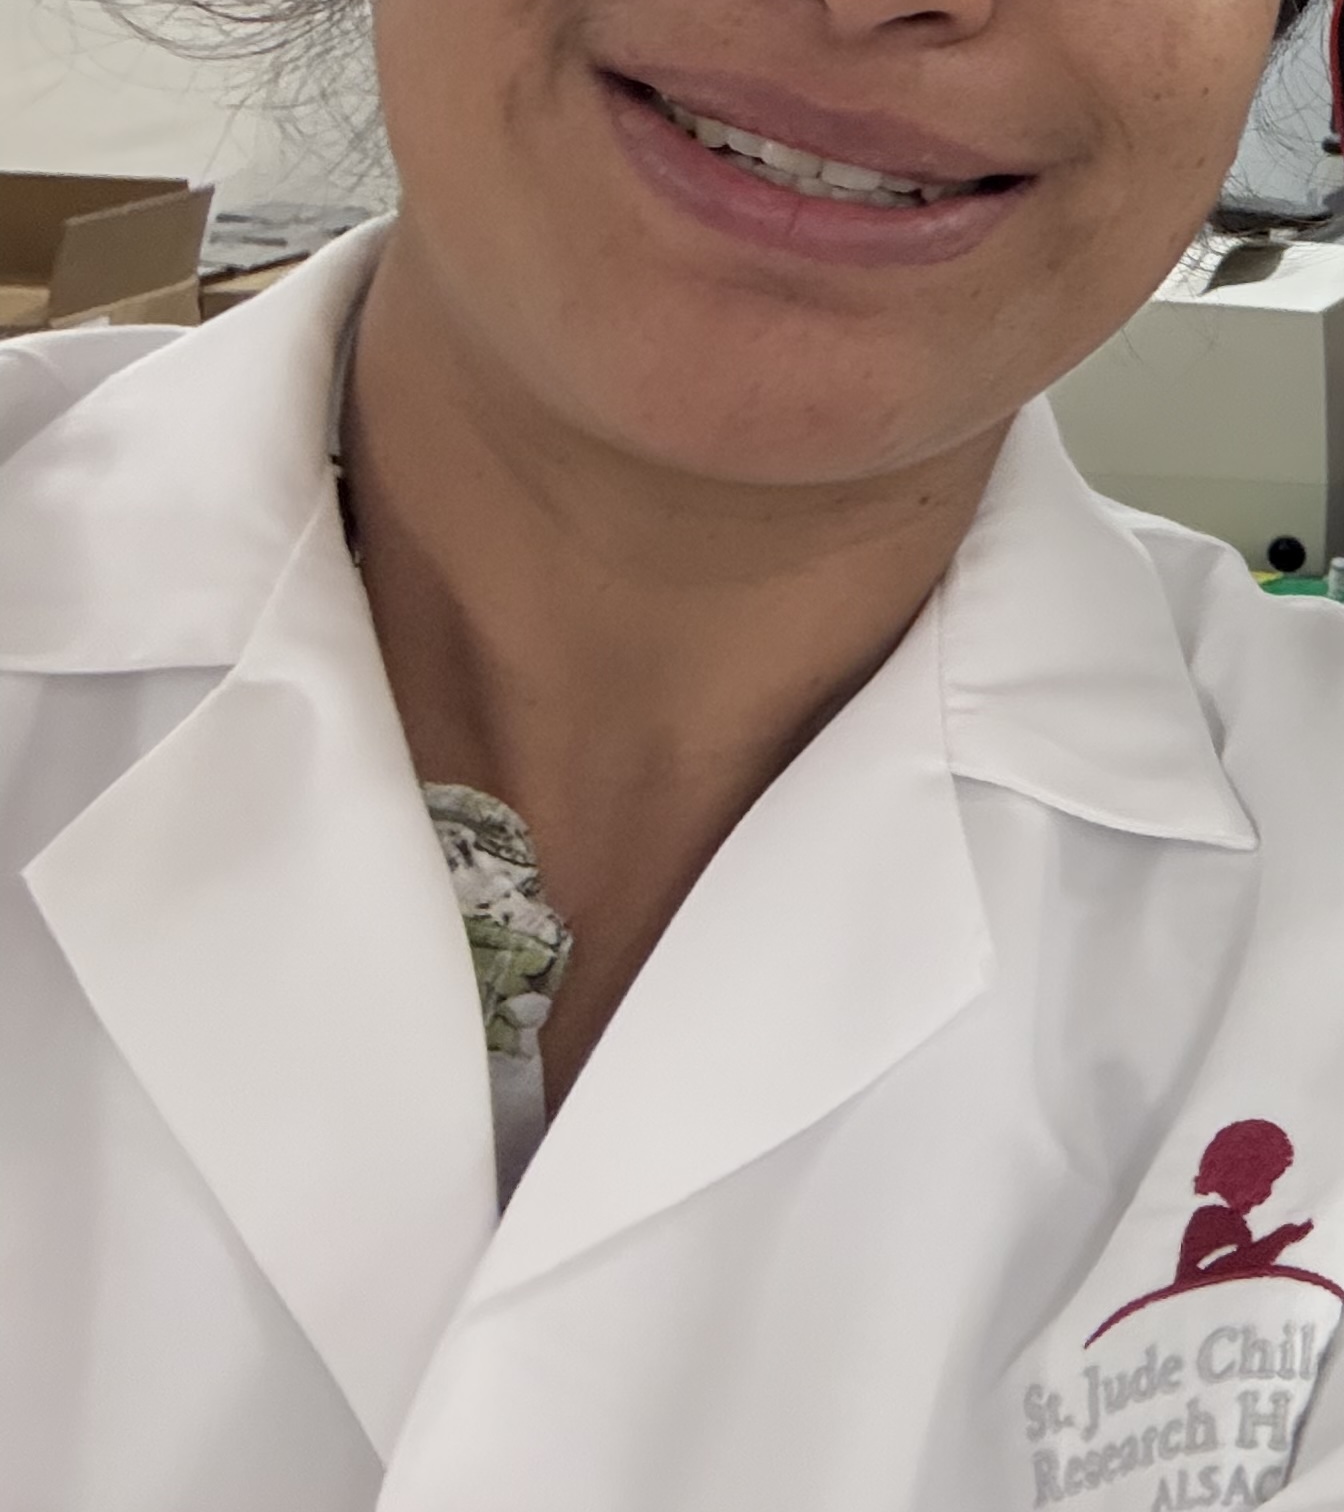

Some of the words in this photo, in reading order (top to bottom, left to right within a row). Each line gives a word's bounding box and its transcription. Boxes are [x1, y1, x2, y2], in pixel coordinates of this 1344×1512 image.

[1023, 1383, 1075, 1443] St.
[1080, 1344, 1184, 1442] Jude
[1032, 1396, 1220, 1510] Research
